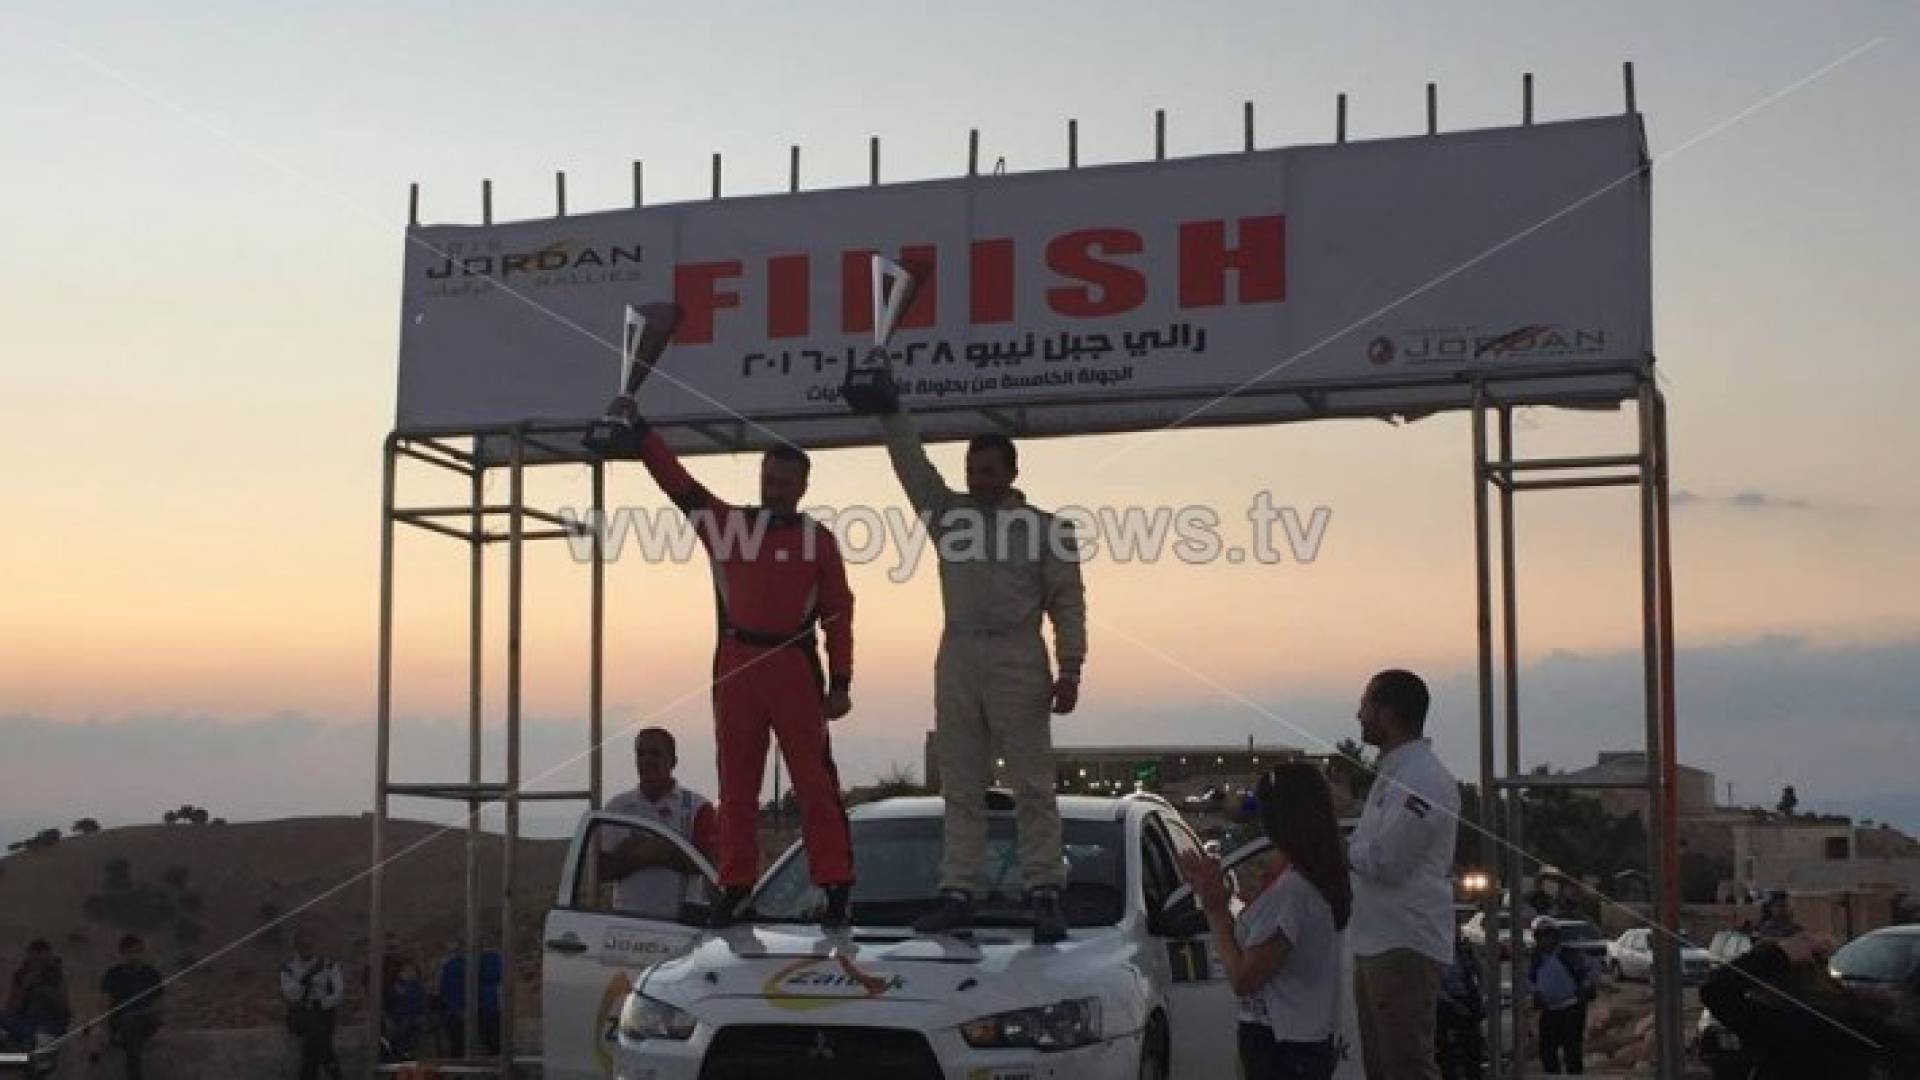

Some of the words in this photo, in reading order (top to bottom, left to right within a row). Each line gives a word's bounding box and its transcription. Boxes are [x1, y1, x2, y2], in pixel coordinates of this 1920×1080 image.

[425, 244, 642, 280] JORDAN
[672, 215, 1287, 345] FINISH
[1044, 332, 1114, 361] جبل
[1124, 323, 1207, 356] رالي
[971, 375, 997, 392] من
